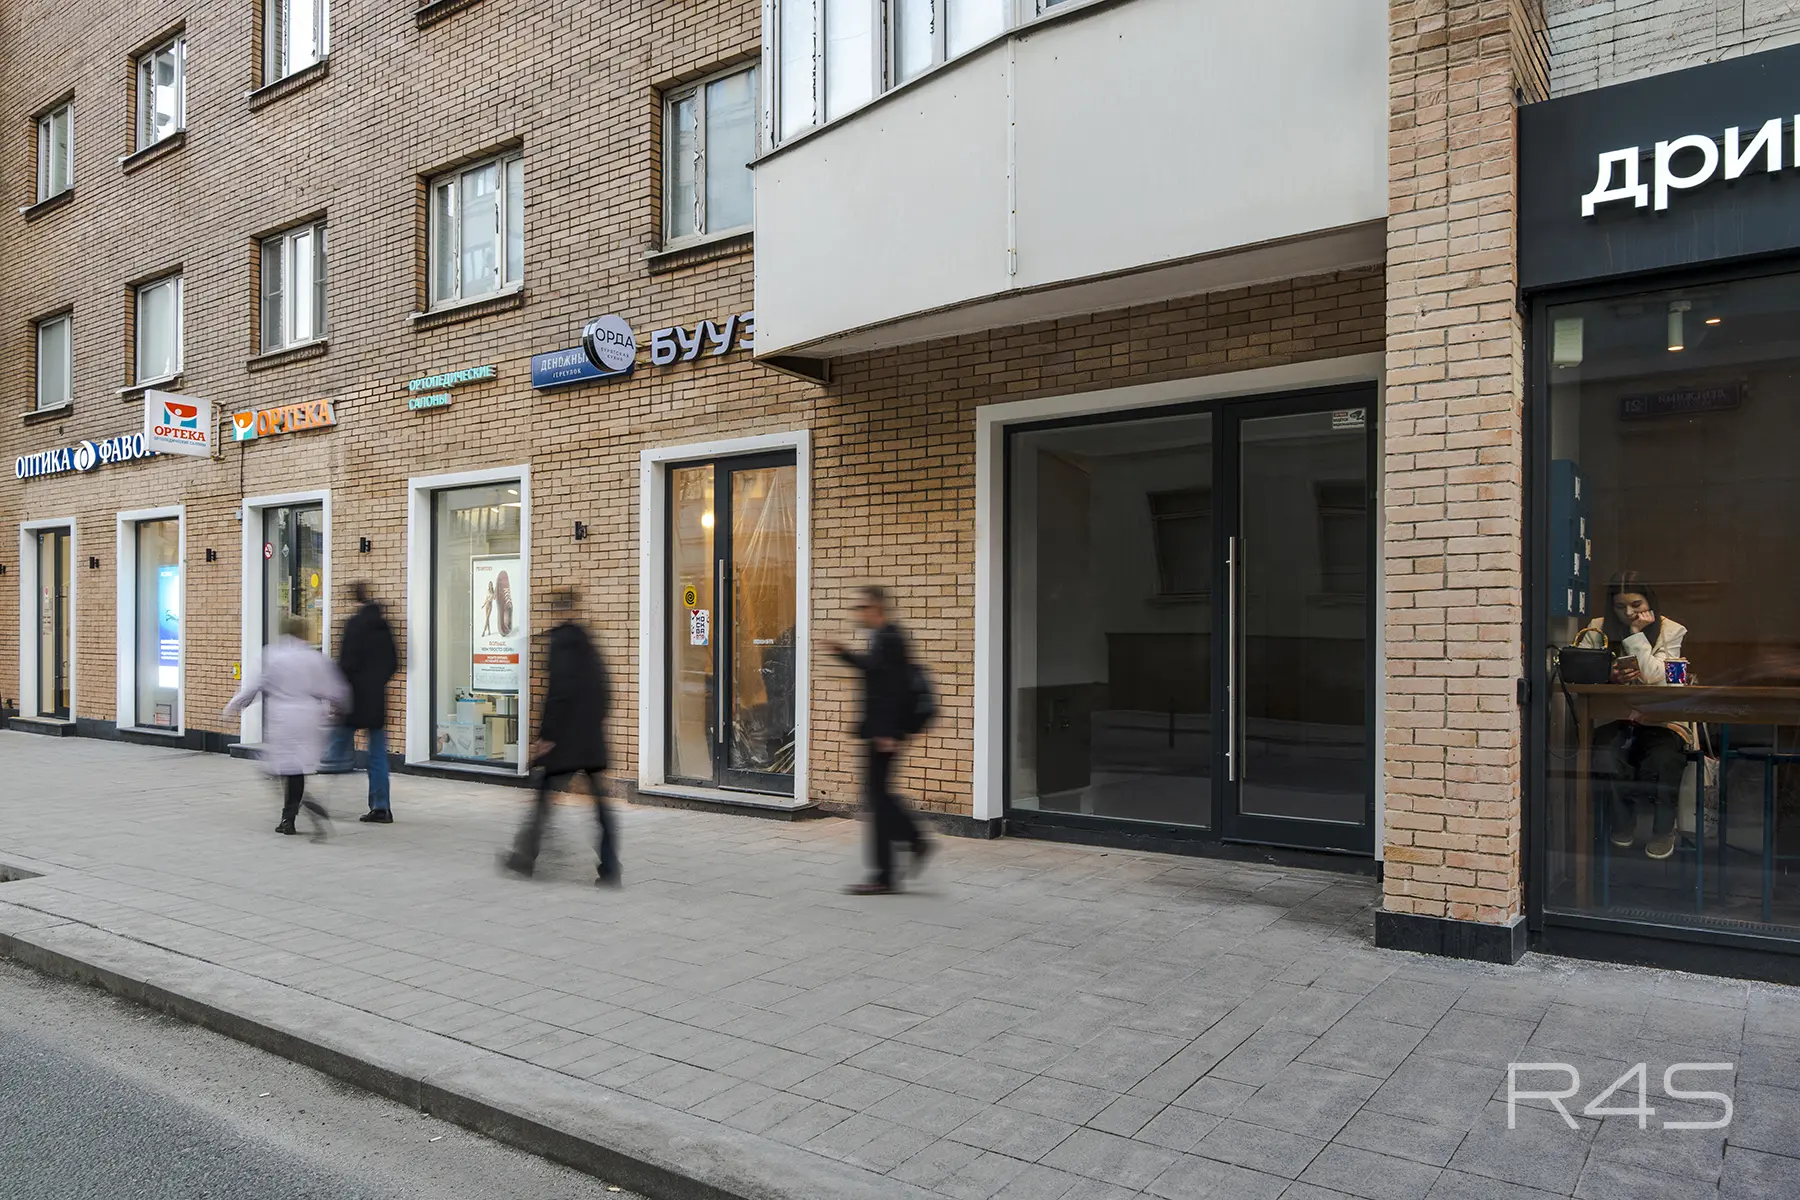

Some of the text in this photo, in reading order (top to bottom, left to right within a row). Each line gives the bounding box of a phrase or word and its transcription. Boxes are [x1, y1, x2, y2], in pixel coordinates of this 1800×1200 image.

[1581, 114, 1800, 218] дри
[595, 327, 635, 350] ОРДА
[408, 365, 493, 391] ОРТОПЕДИЧЕСКИЕ
[408, 393, 450, 411] САЛОНЫ
[257, 399, 331, 436] ОРТЕКА
[153, 425, 207, 442] ОРТЕКА
[15, 432, 160, 479] ОПТИКА ФАВО
